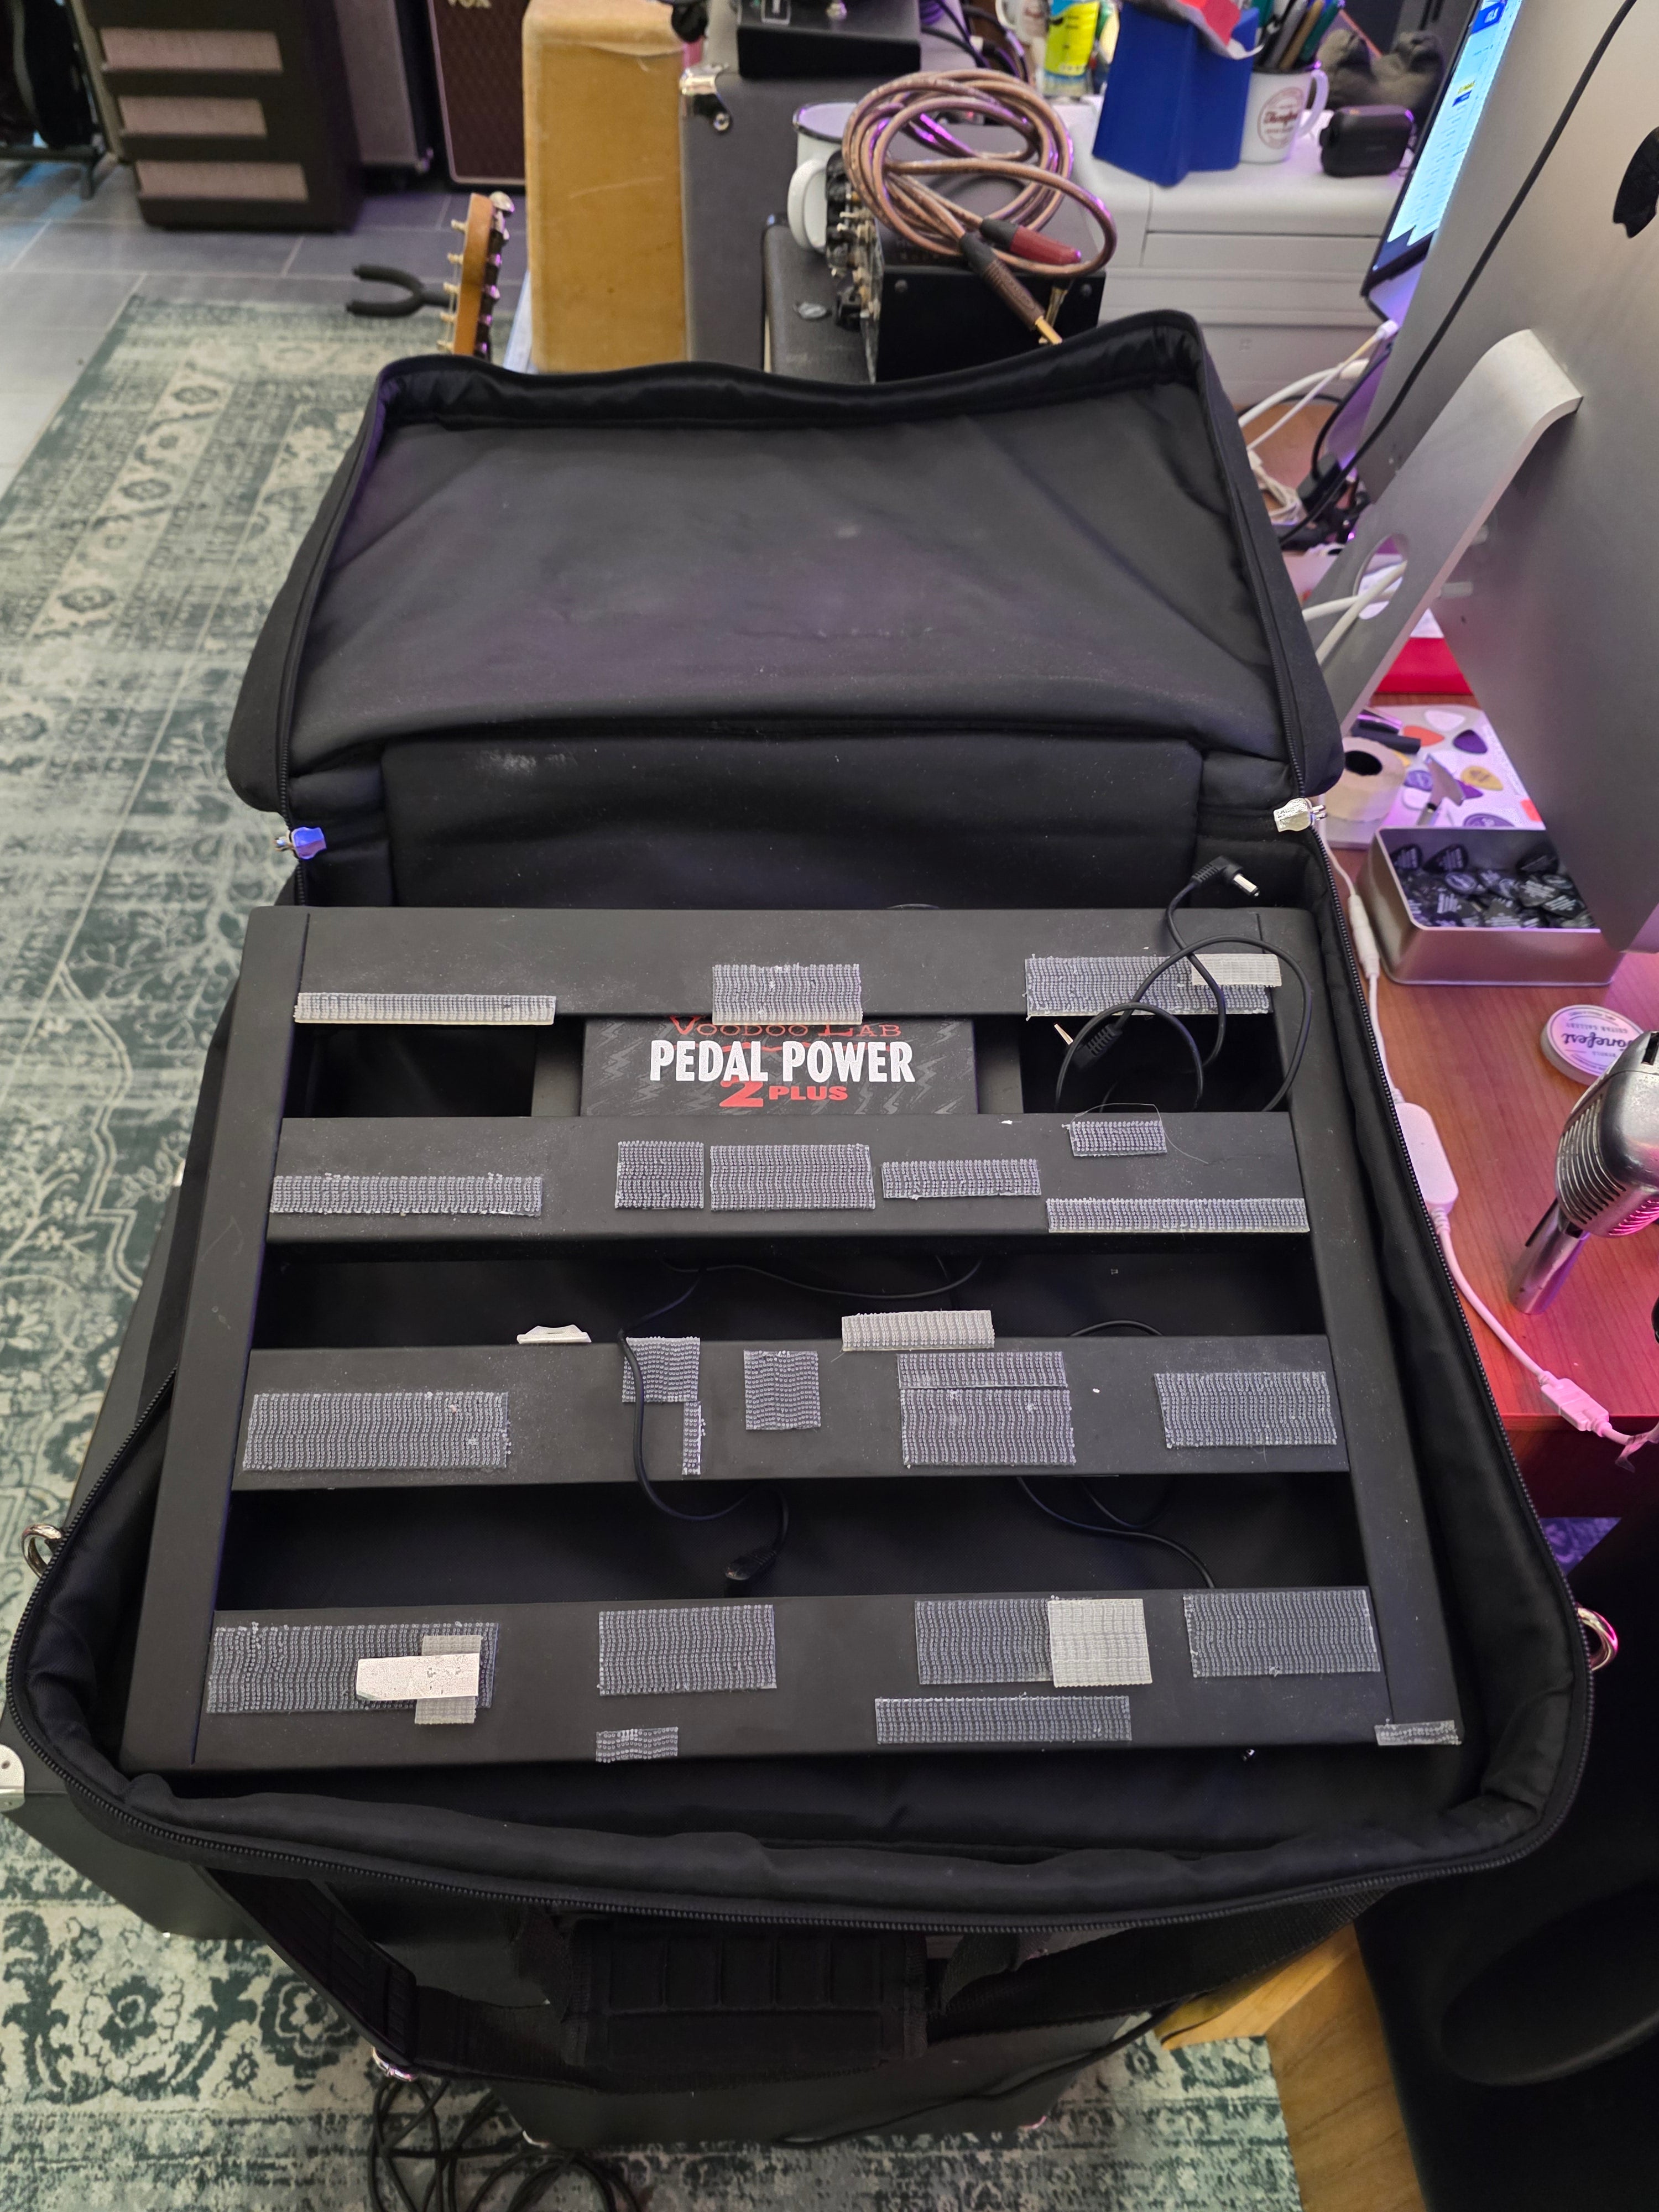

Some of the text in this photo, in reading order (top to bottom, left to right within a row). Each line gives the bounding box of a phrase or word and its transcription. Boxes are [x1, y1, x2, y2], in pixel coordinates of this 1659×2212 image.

[1561, 1032, 1633, 1051] onefest
[650, 1040, 916, 1083] PEDAL POWER
[719, 1076, 848, 1107] 2 PLUS
